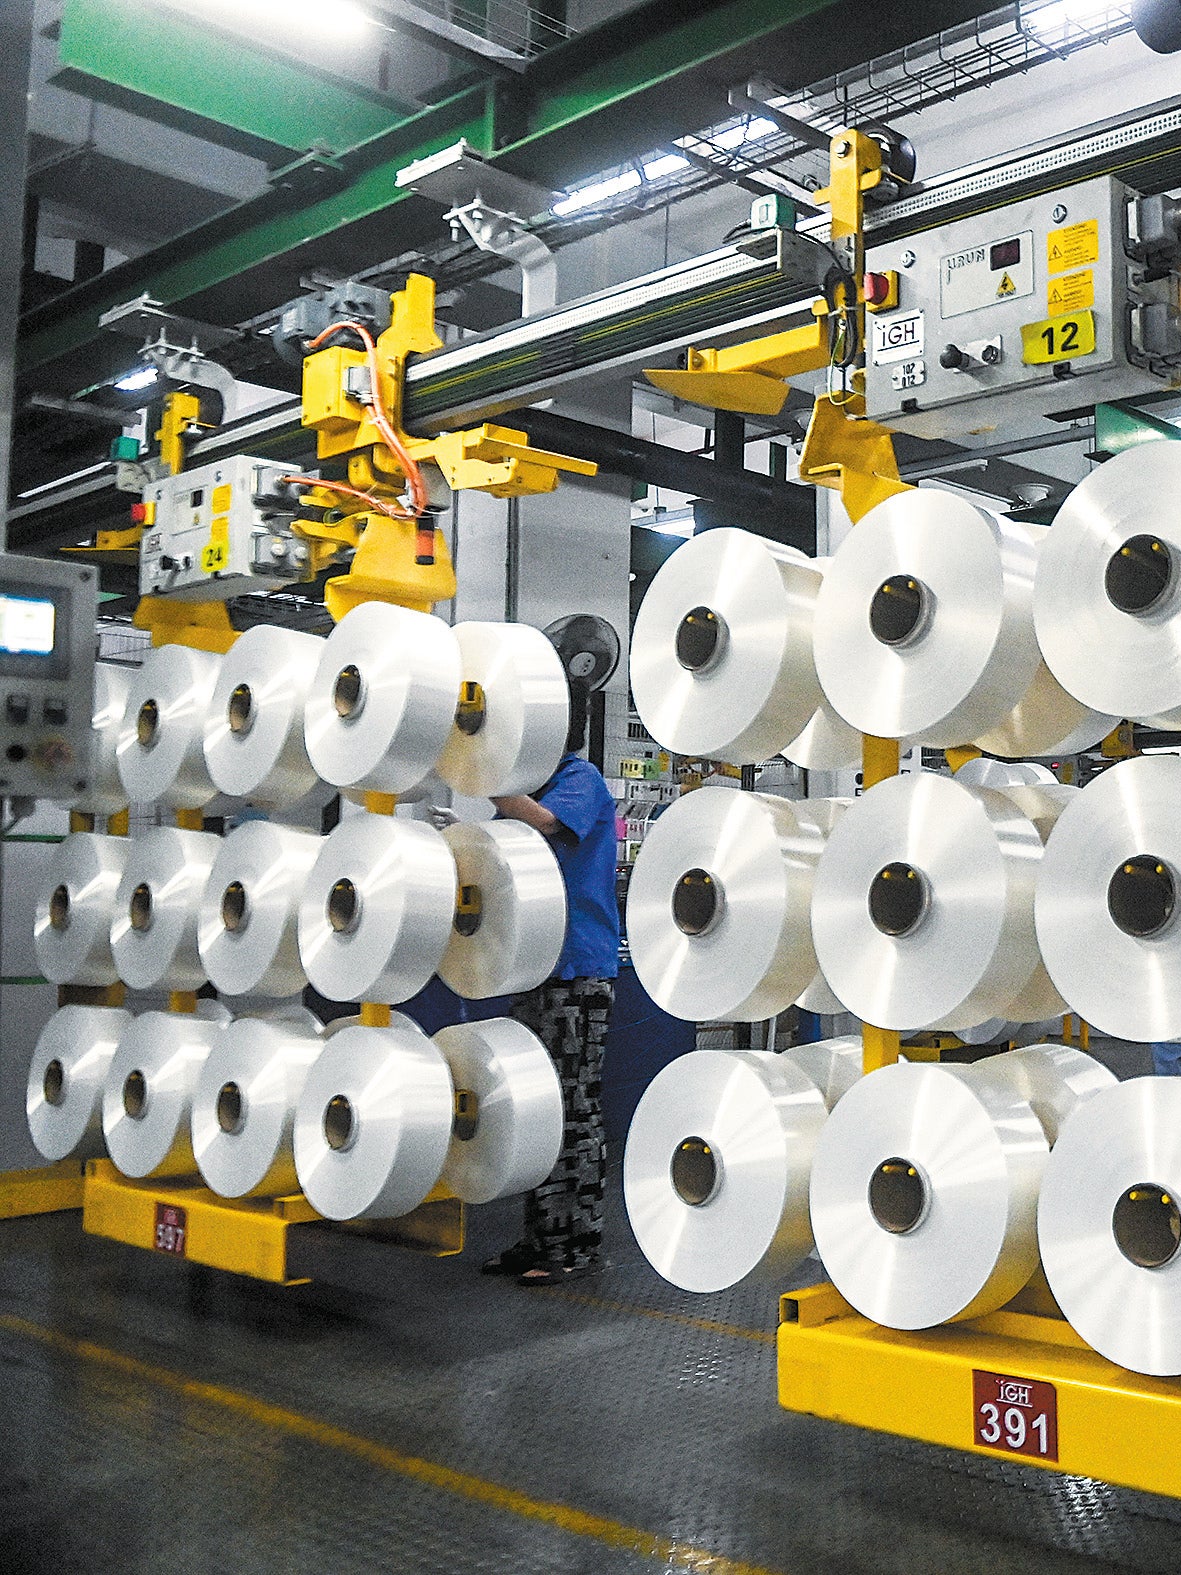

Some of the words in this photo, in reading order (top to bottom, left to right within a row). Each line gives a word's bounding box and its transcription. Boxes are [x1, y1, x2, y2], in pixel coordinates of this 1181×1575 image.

[1041, 321, 1079, 355] 12
[206, 547, 224, 567] 24
[980, 1403, 1047, 1454] 391
